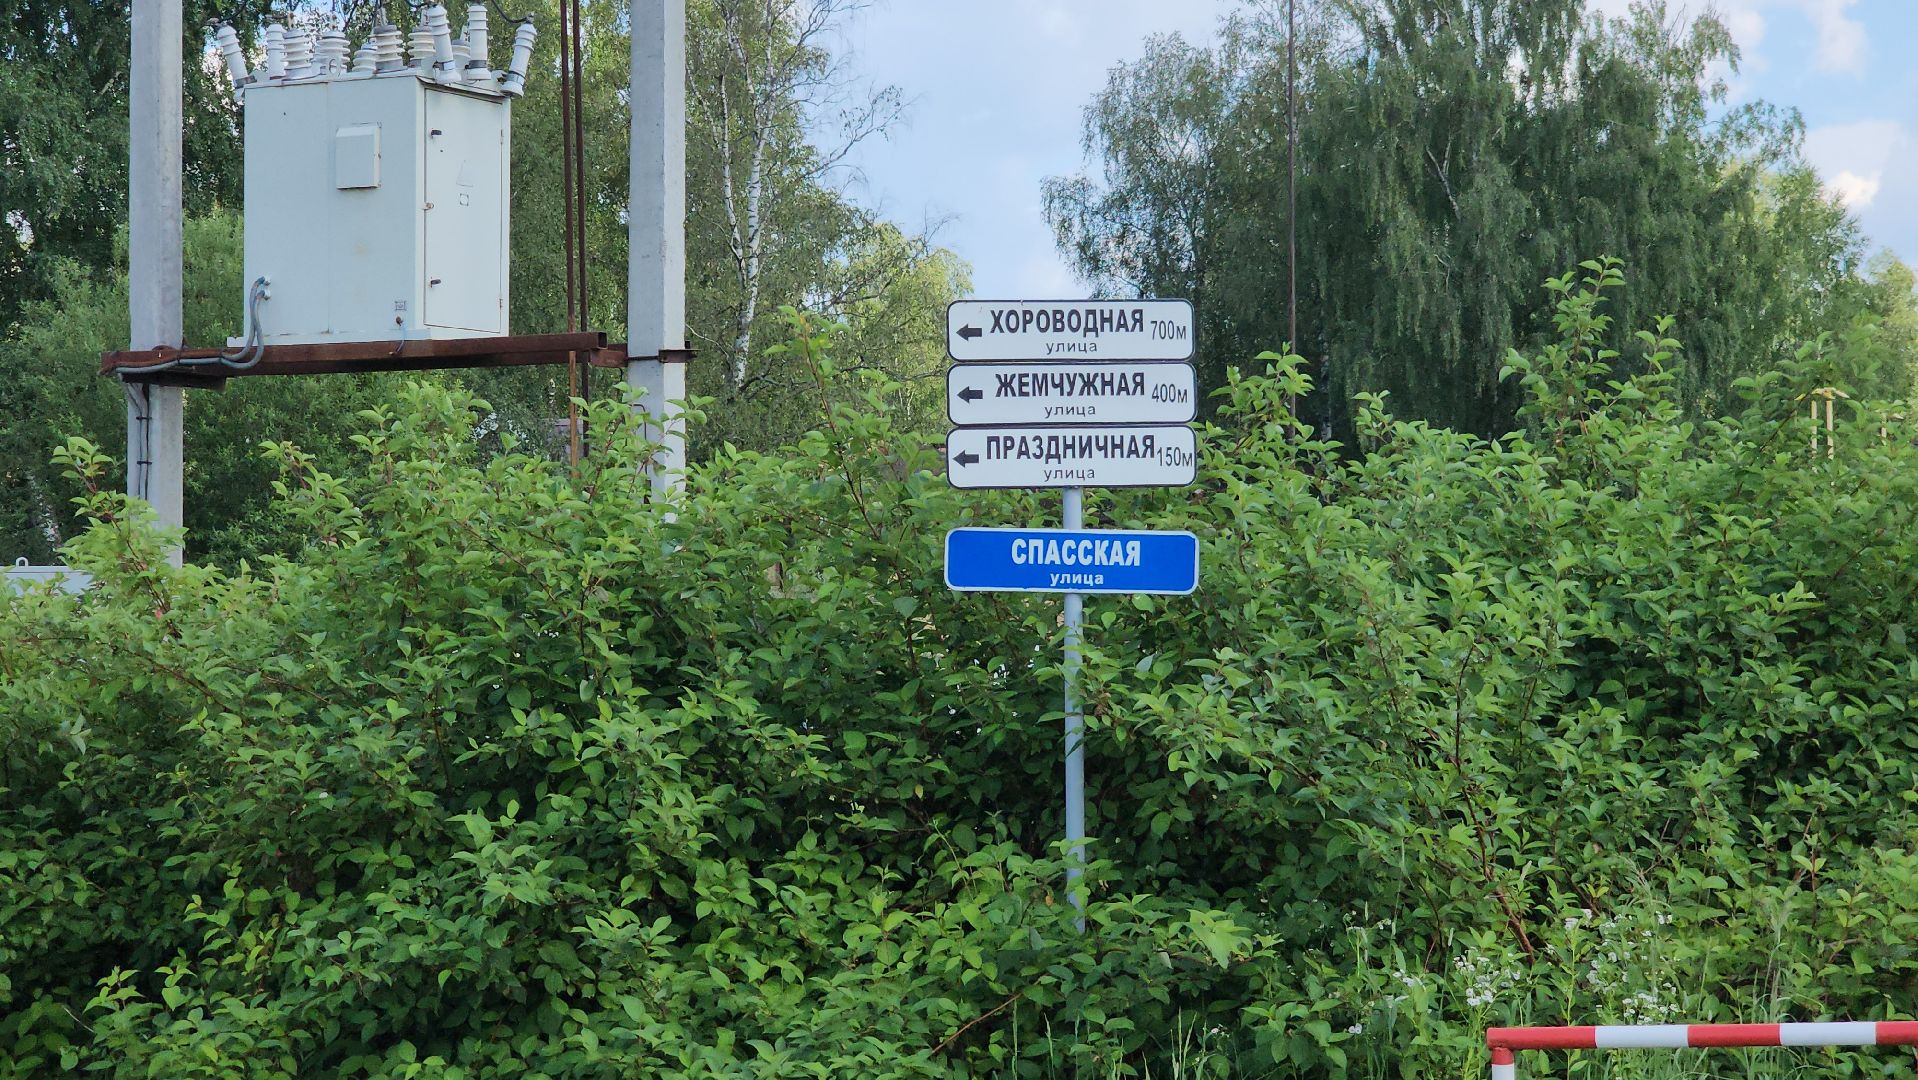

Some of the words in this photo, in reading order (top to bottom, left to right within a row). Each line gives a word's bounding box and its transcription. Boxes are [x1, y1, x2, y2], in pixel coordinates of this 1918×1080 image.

[990, 309, 1144, 338] ХОРОВОДНАЯ
[1046, 341, 1098, 355] улица
[995, 372, 1145, 397] ЖЕМЧУЖНАЯ
[1044, 404, 1096, 418] улица
[986, 434, 1155, 464] ПРАЗДНИЧНАЯ
[1043, 468, 1095, 482] улица
[1011, 538, 1141, 567] СПАССКАЯ
[1050, 572, 1104, 587] улица
